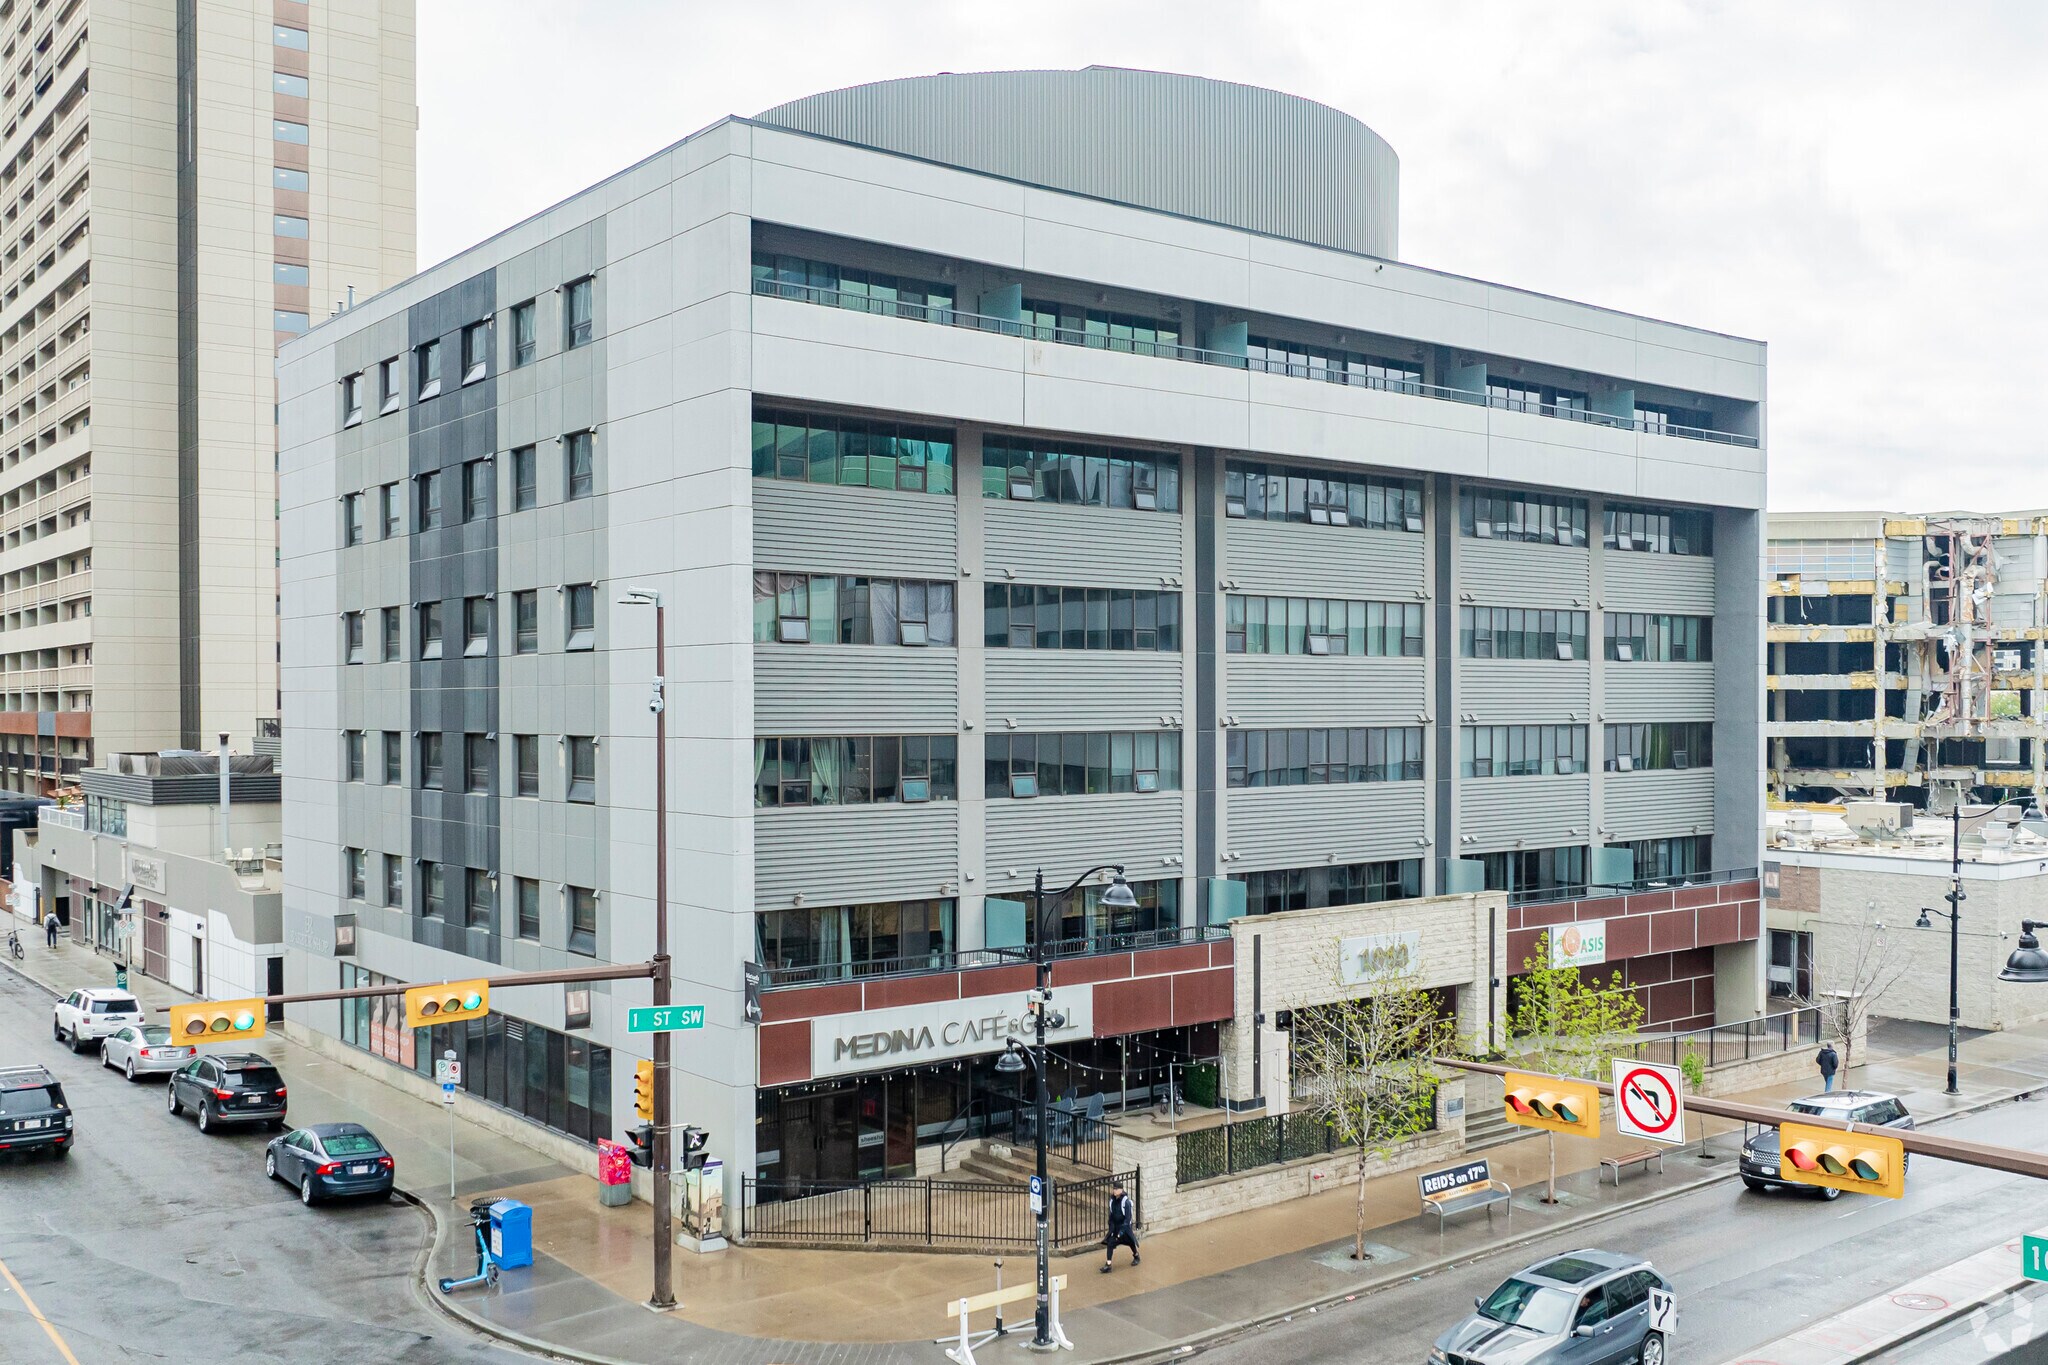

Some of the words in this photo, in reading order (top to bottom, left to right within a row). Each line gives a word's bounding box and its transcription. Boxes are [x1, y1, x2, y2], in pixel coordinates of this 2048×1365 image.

[338, 928, 353, 943] L1
[568, 992, 587, 1012] L1
[632, 1012, 638, 1028] 1
[653, 1011, 671, 1026] ST
[681, 1009, 702, 1025] SW
[835, 1026, 935, 1062] MEDINA
[1424, 1173, 1455, 1192] REID'S
[1456, 1174, 1467, 1184] on
[1468, 1165, 1486, 1180] 17th
[2032, 1245, 2048, 1271] 1
